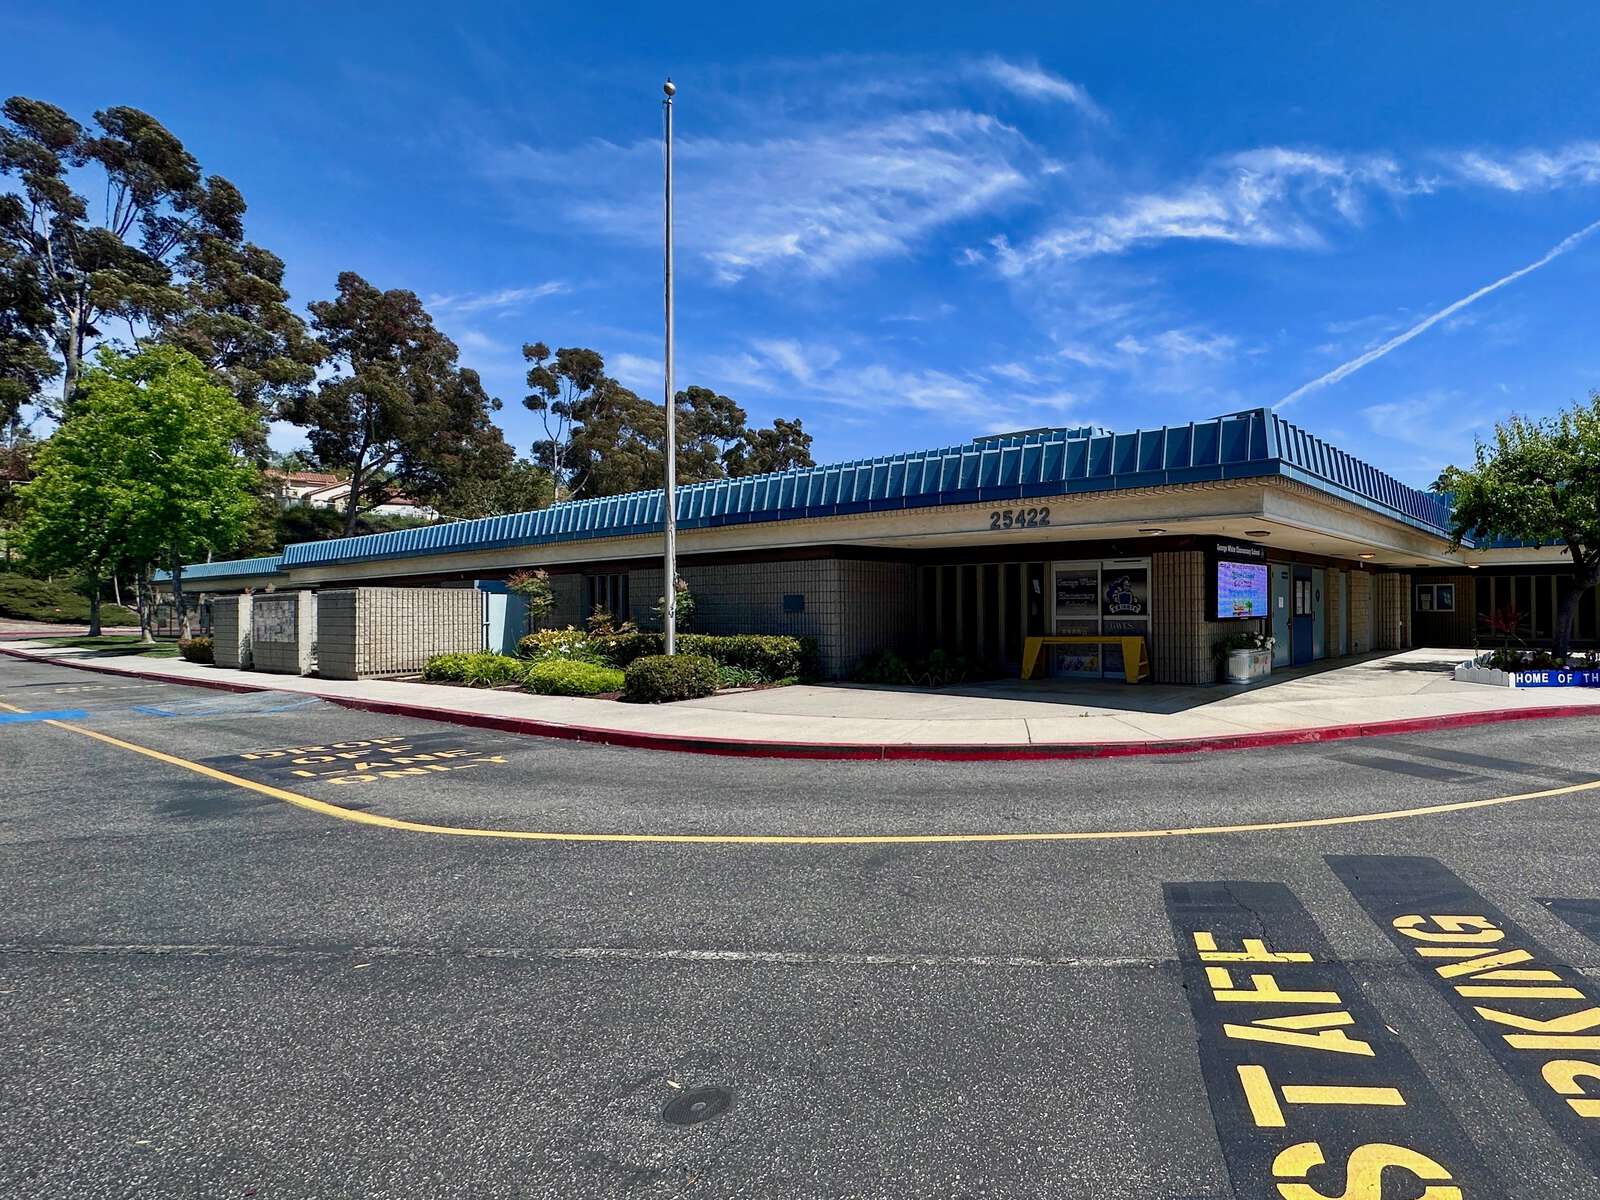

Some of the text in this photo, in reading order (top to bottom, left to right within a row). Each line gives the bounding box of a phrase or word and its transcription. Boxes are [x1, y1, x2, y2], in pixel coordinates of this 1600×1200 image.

[990, 506, 1050, 529] 25422
[1516, 672, 1549, 684] HOME
[1557, 673, 1573, 684] OF
[239, 736, 406, 760] DROP
[291, 743, 415, 766] OFF
[290, 748, 483, 778] LANE
[326, 755, 509, 785] ONLY
[1192, 931, 1463, 1200] STAFF
